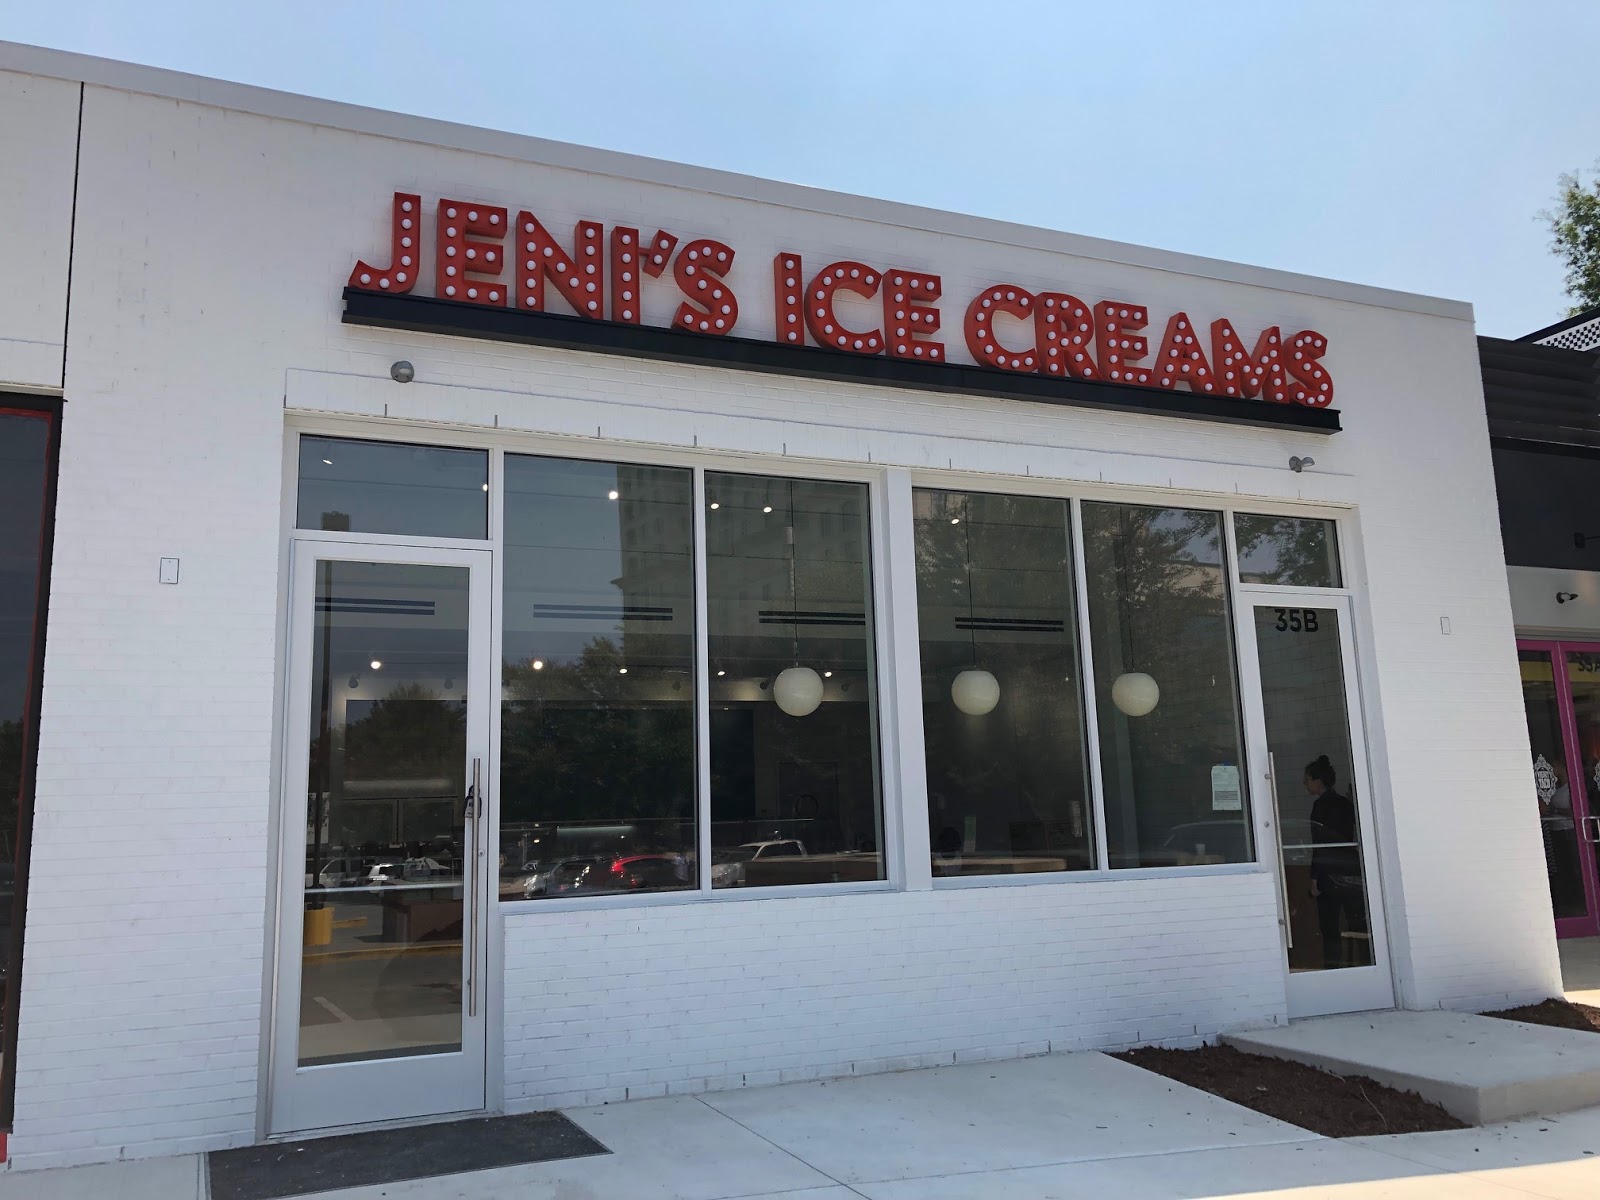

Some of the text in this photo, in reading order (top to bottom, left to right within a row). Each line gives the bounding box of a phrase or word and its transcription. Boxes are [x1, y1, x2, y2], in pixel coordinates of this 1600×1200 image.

[347, 192, 1334, 407] JENI'S ICE CREAMS
[1274, 608, 1319, 632] 35B
